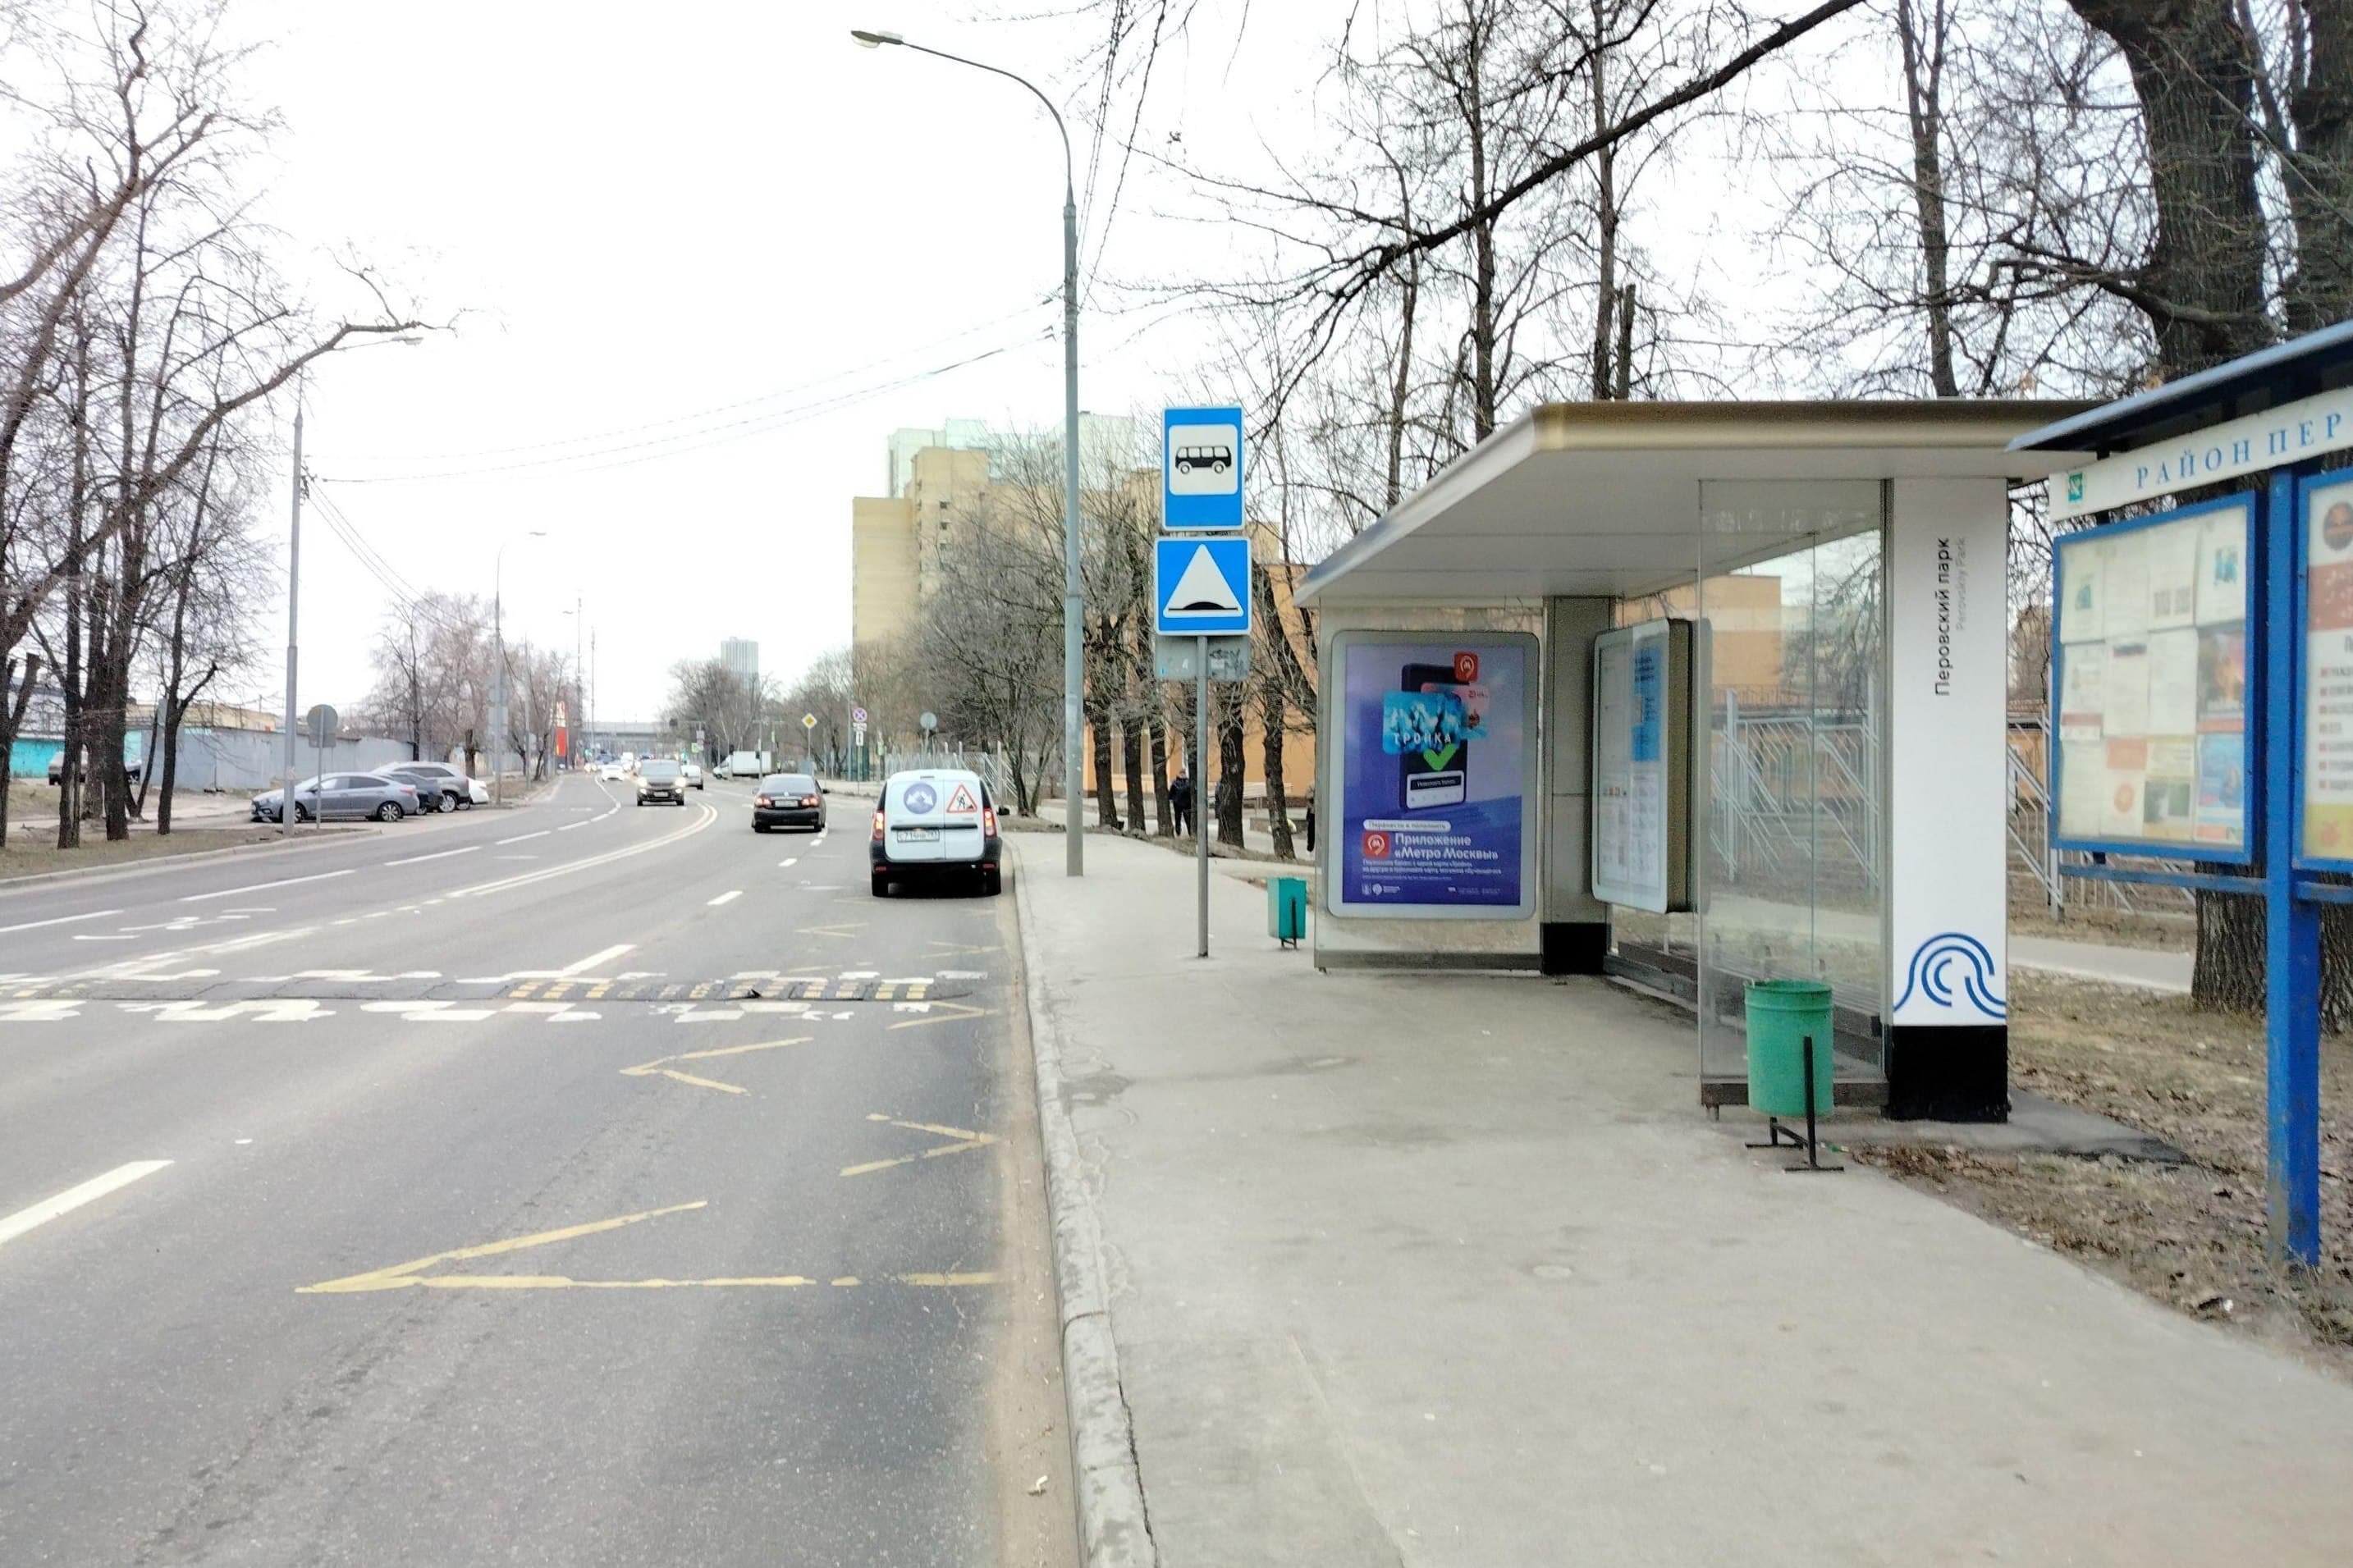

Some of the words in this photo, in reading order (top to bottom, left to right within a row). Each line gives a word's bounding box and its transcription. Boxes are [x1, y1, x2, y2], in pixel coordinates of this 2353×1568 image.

[2136, 437, 2251, 489] РАЙОН
[2268, 413, 2342, 456] ПЕР
[1937, 537, 1953, 584] парк
[1934, 590, 1954, 696] Перовский
[1393, 731, 1452, 745] ТРОЙКА
[1394, 847, 1441, 861] «Метро
[1443, 847, 1499, 860] Москвы»
[1395, 833, 1472, 847] Приложение
